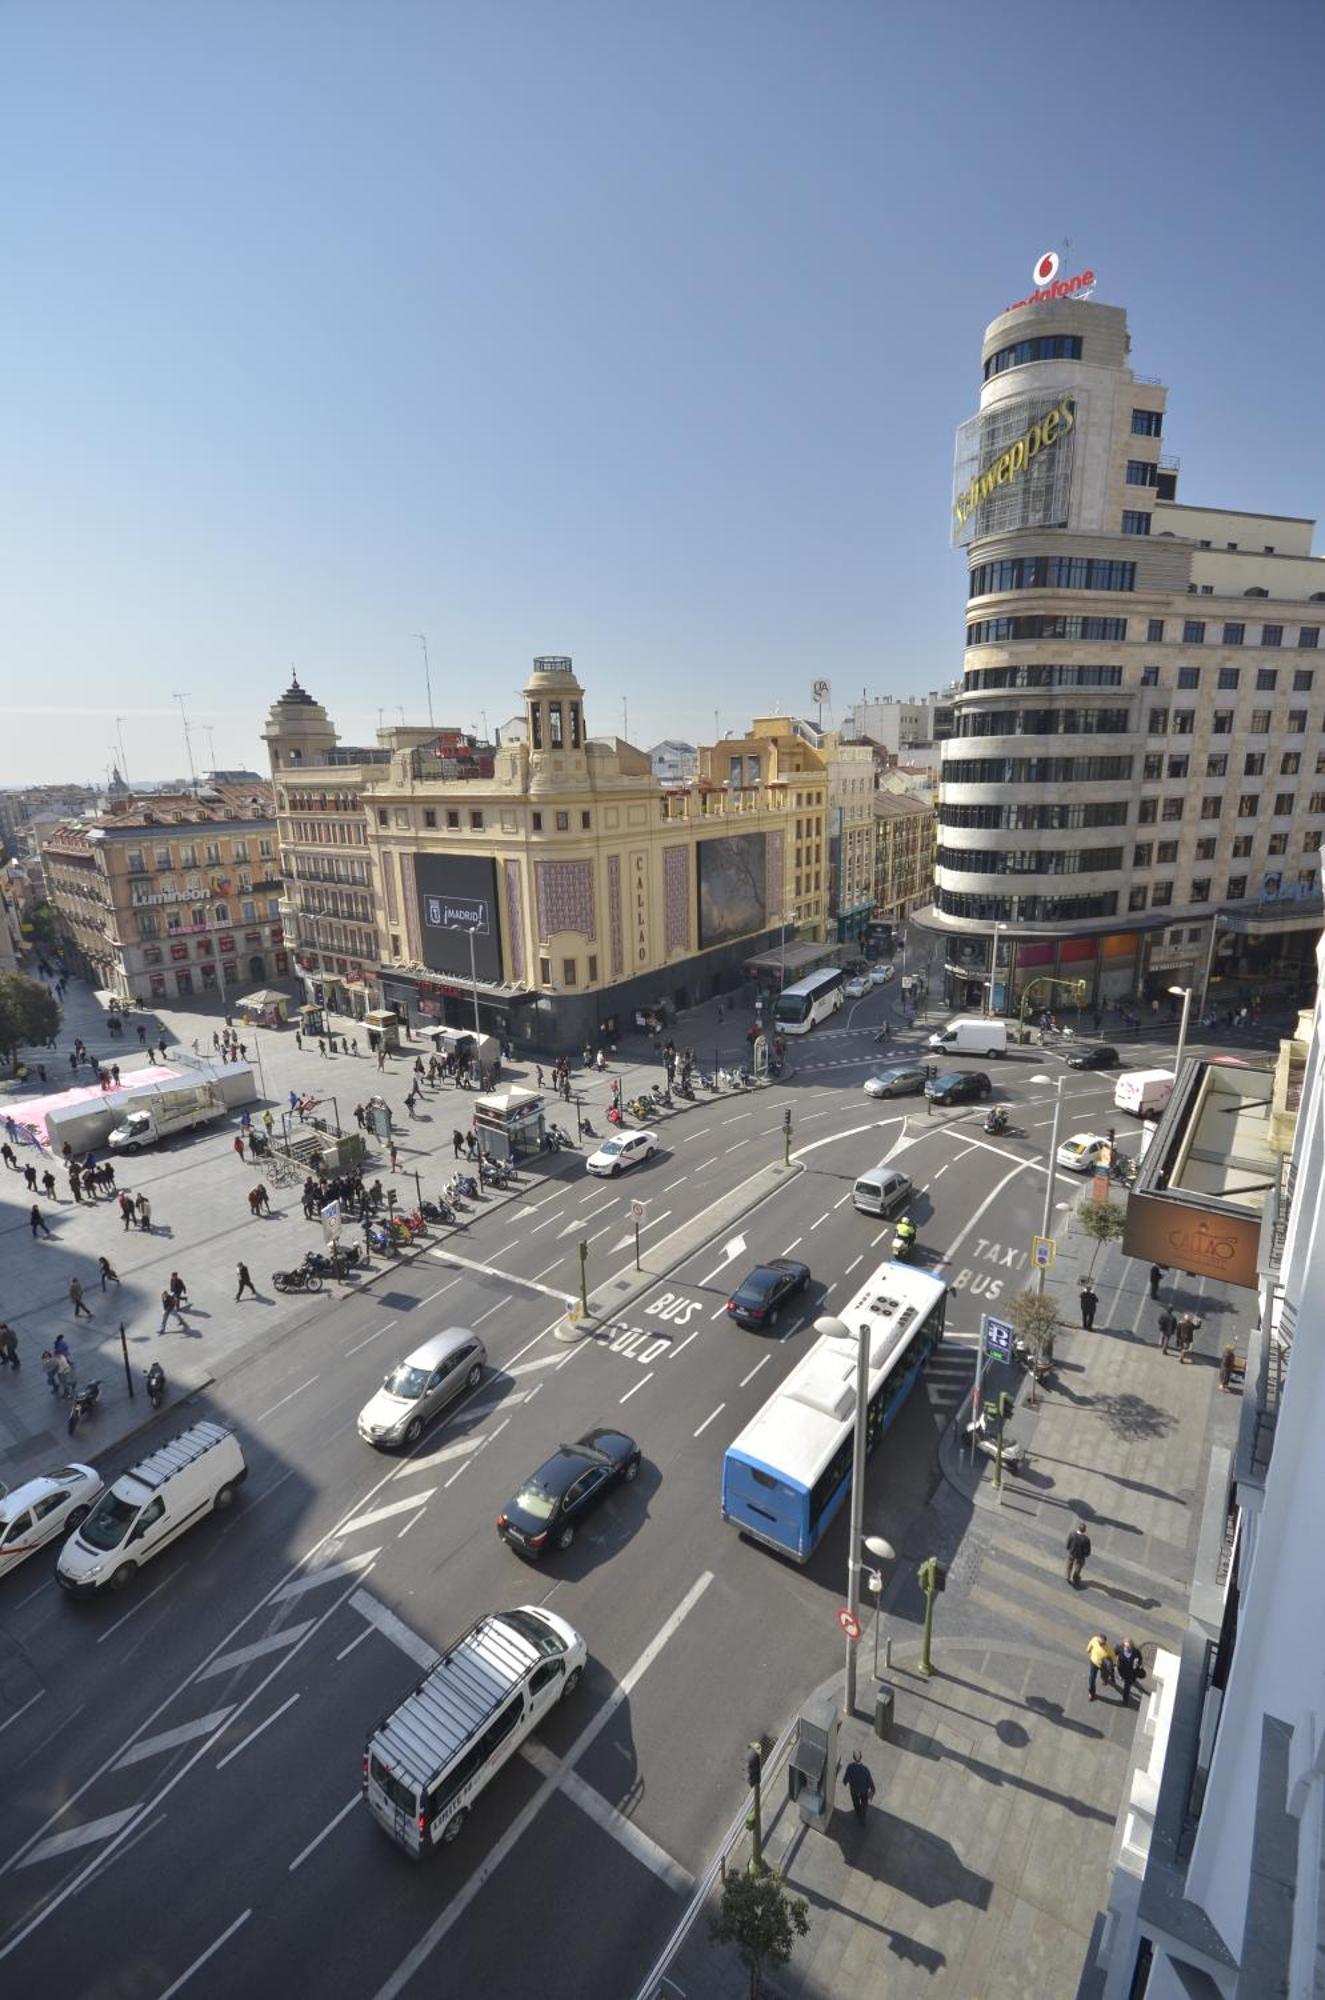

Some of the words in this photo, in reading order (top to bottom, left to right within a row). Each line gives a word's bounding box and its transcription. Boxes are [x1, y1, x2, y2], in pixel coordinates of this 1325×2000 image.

[953, 390, 1076, 538] Schweppes
[636, 857, 646, 960] CALLAO
[973, 1239, 1028, 1270] TAXI
[952, 1268, 1004, 1300] BUS
[643, 1292, 703, 1325] BUS
